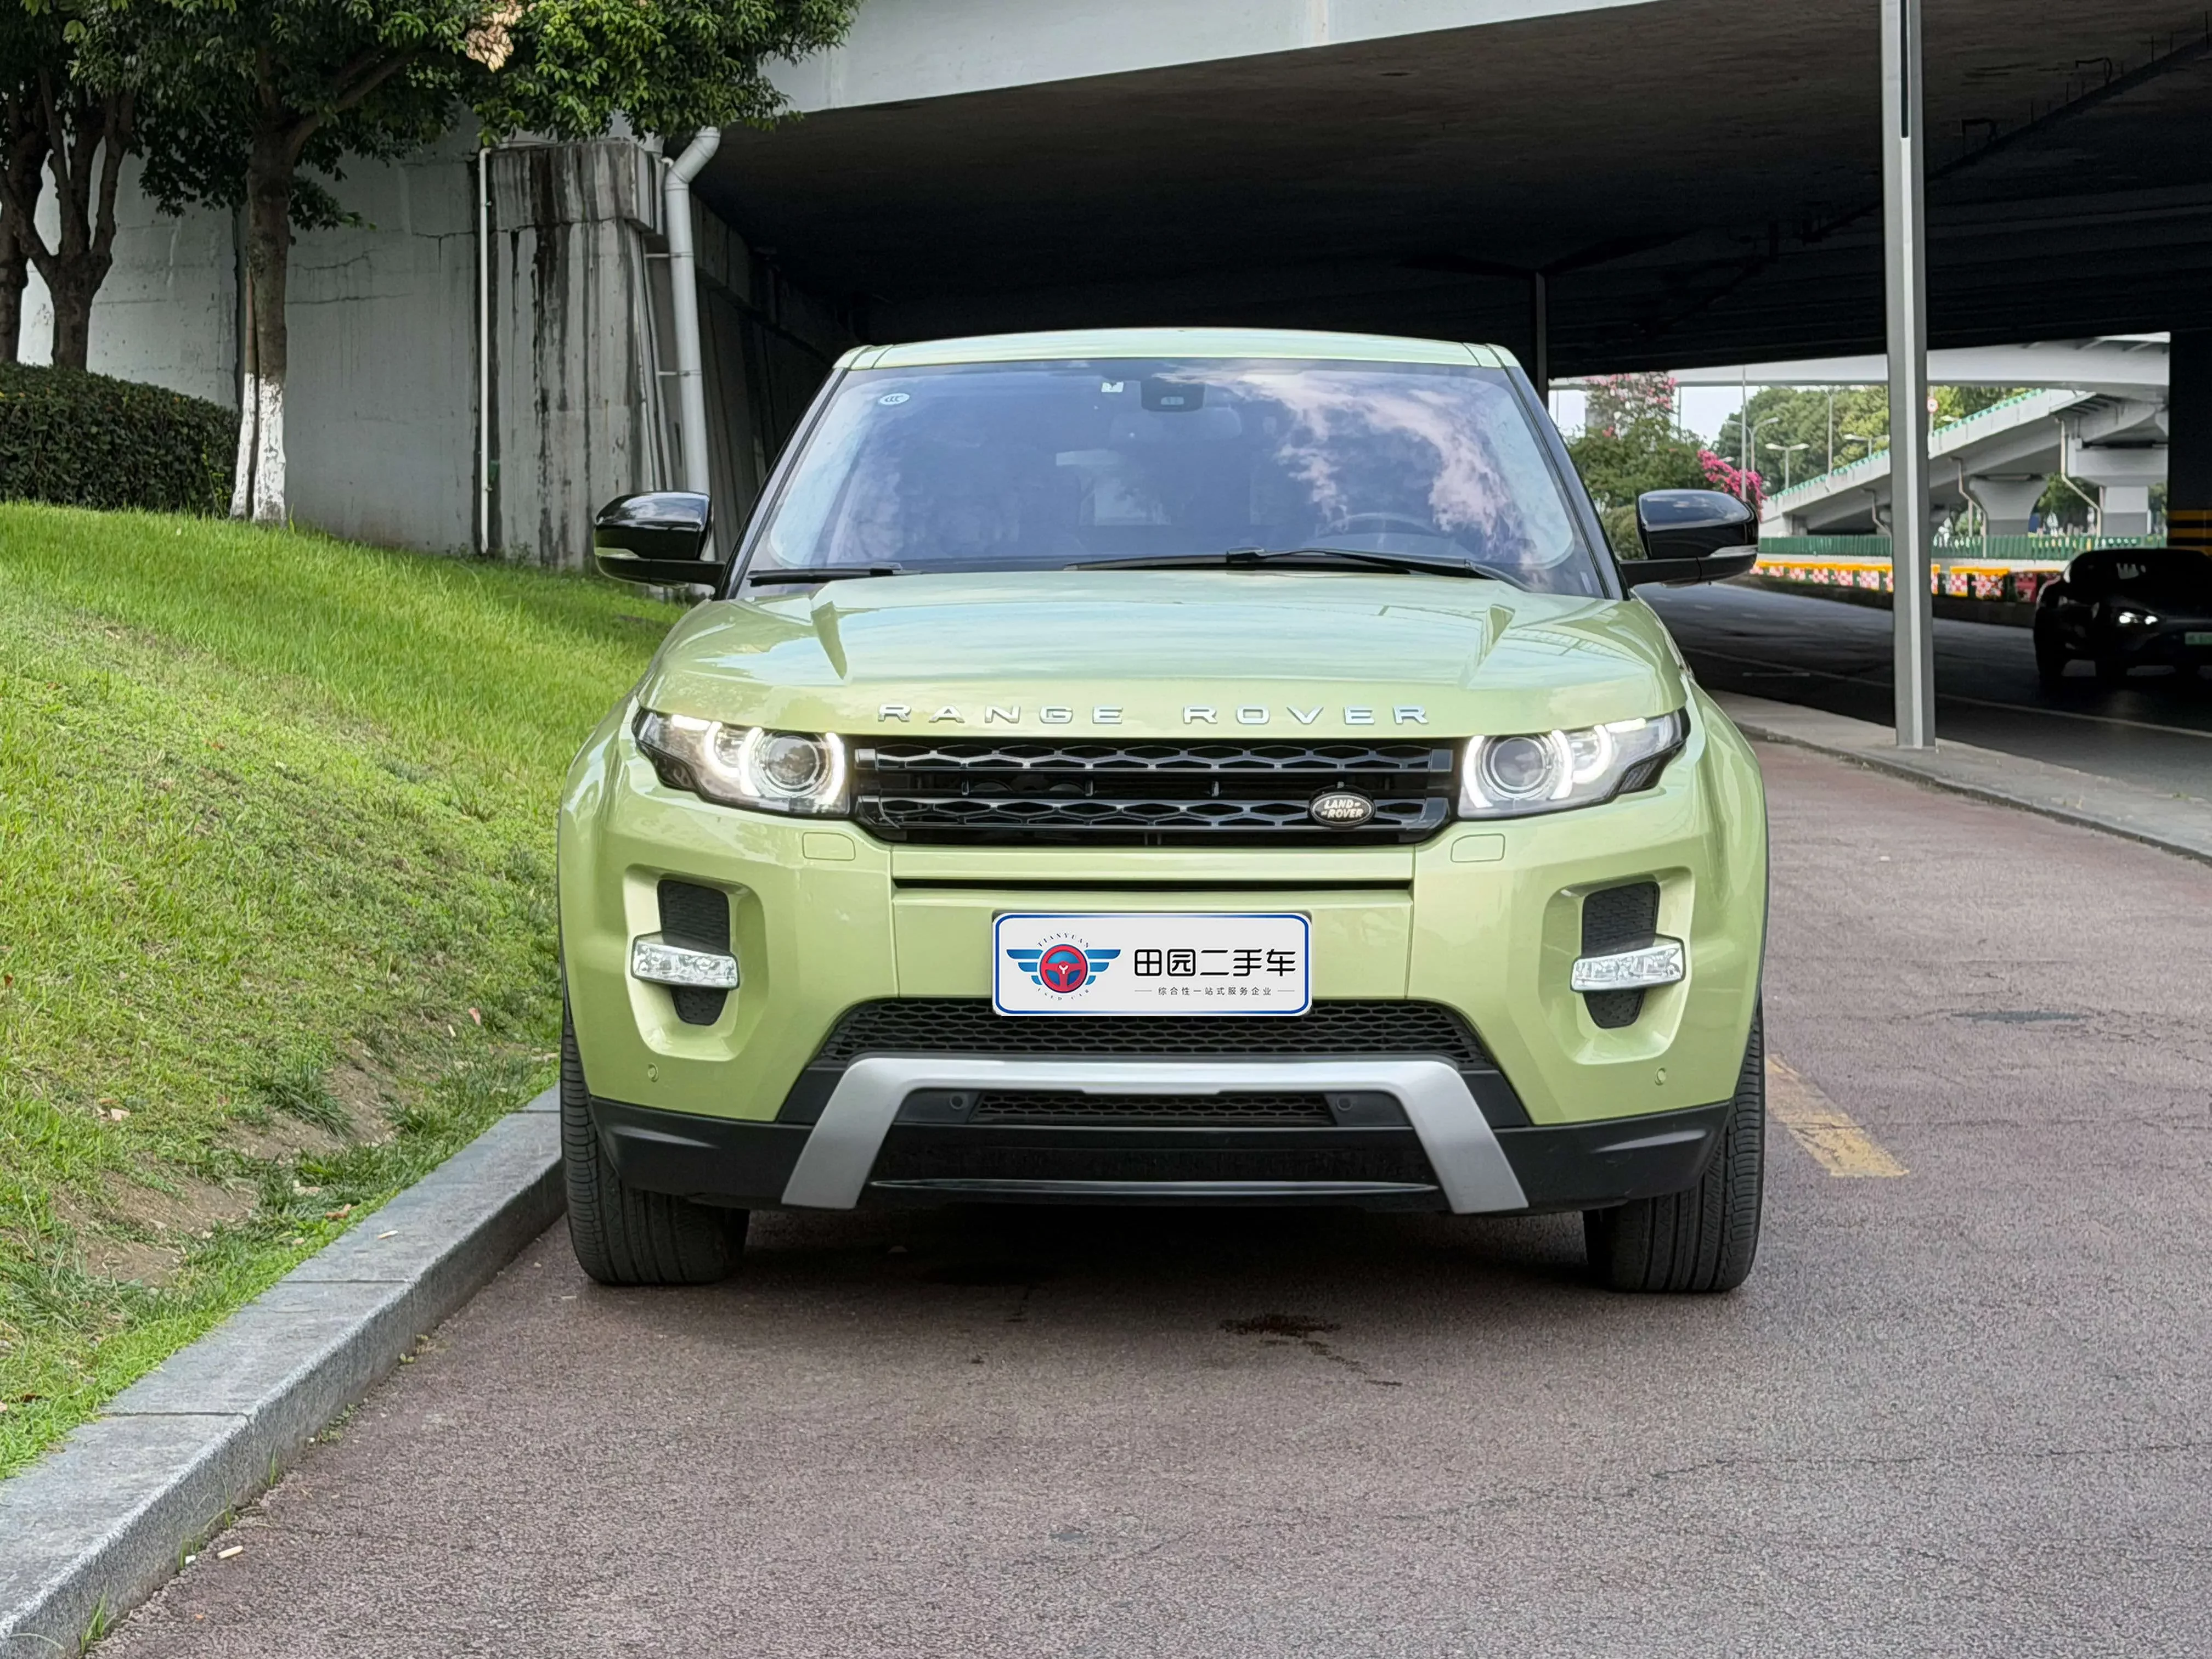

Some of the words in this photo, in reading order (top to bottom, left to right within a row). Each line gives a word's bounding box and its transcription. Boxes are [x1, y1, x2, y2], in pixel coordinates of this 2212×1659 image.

[878, 704, 1123, 724] RANGE
[1183, 705, 1429, 724] ROVER
[1328, 809, 1364, 818] ROVER
